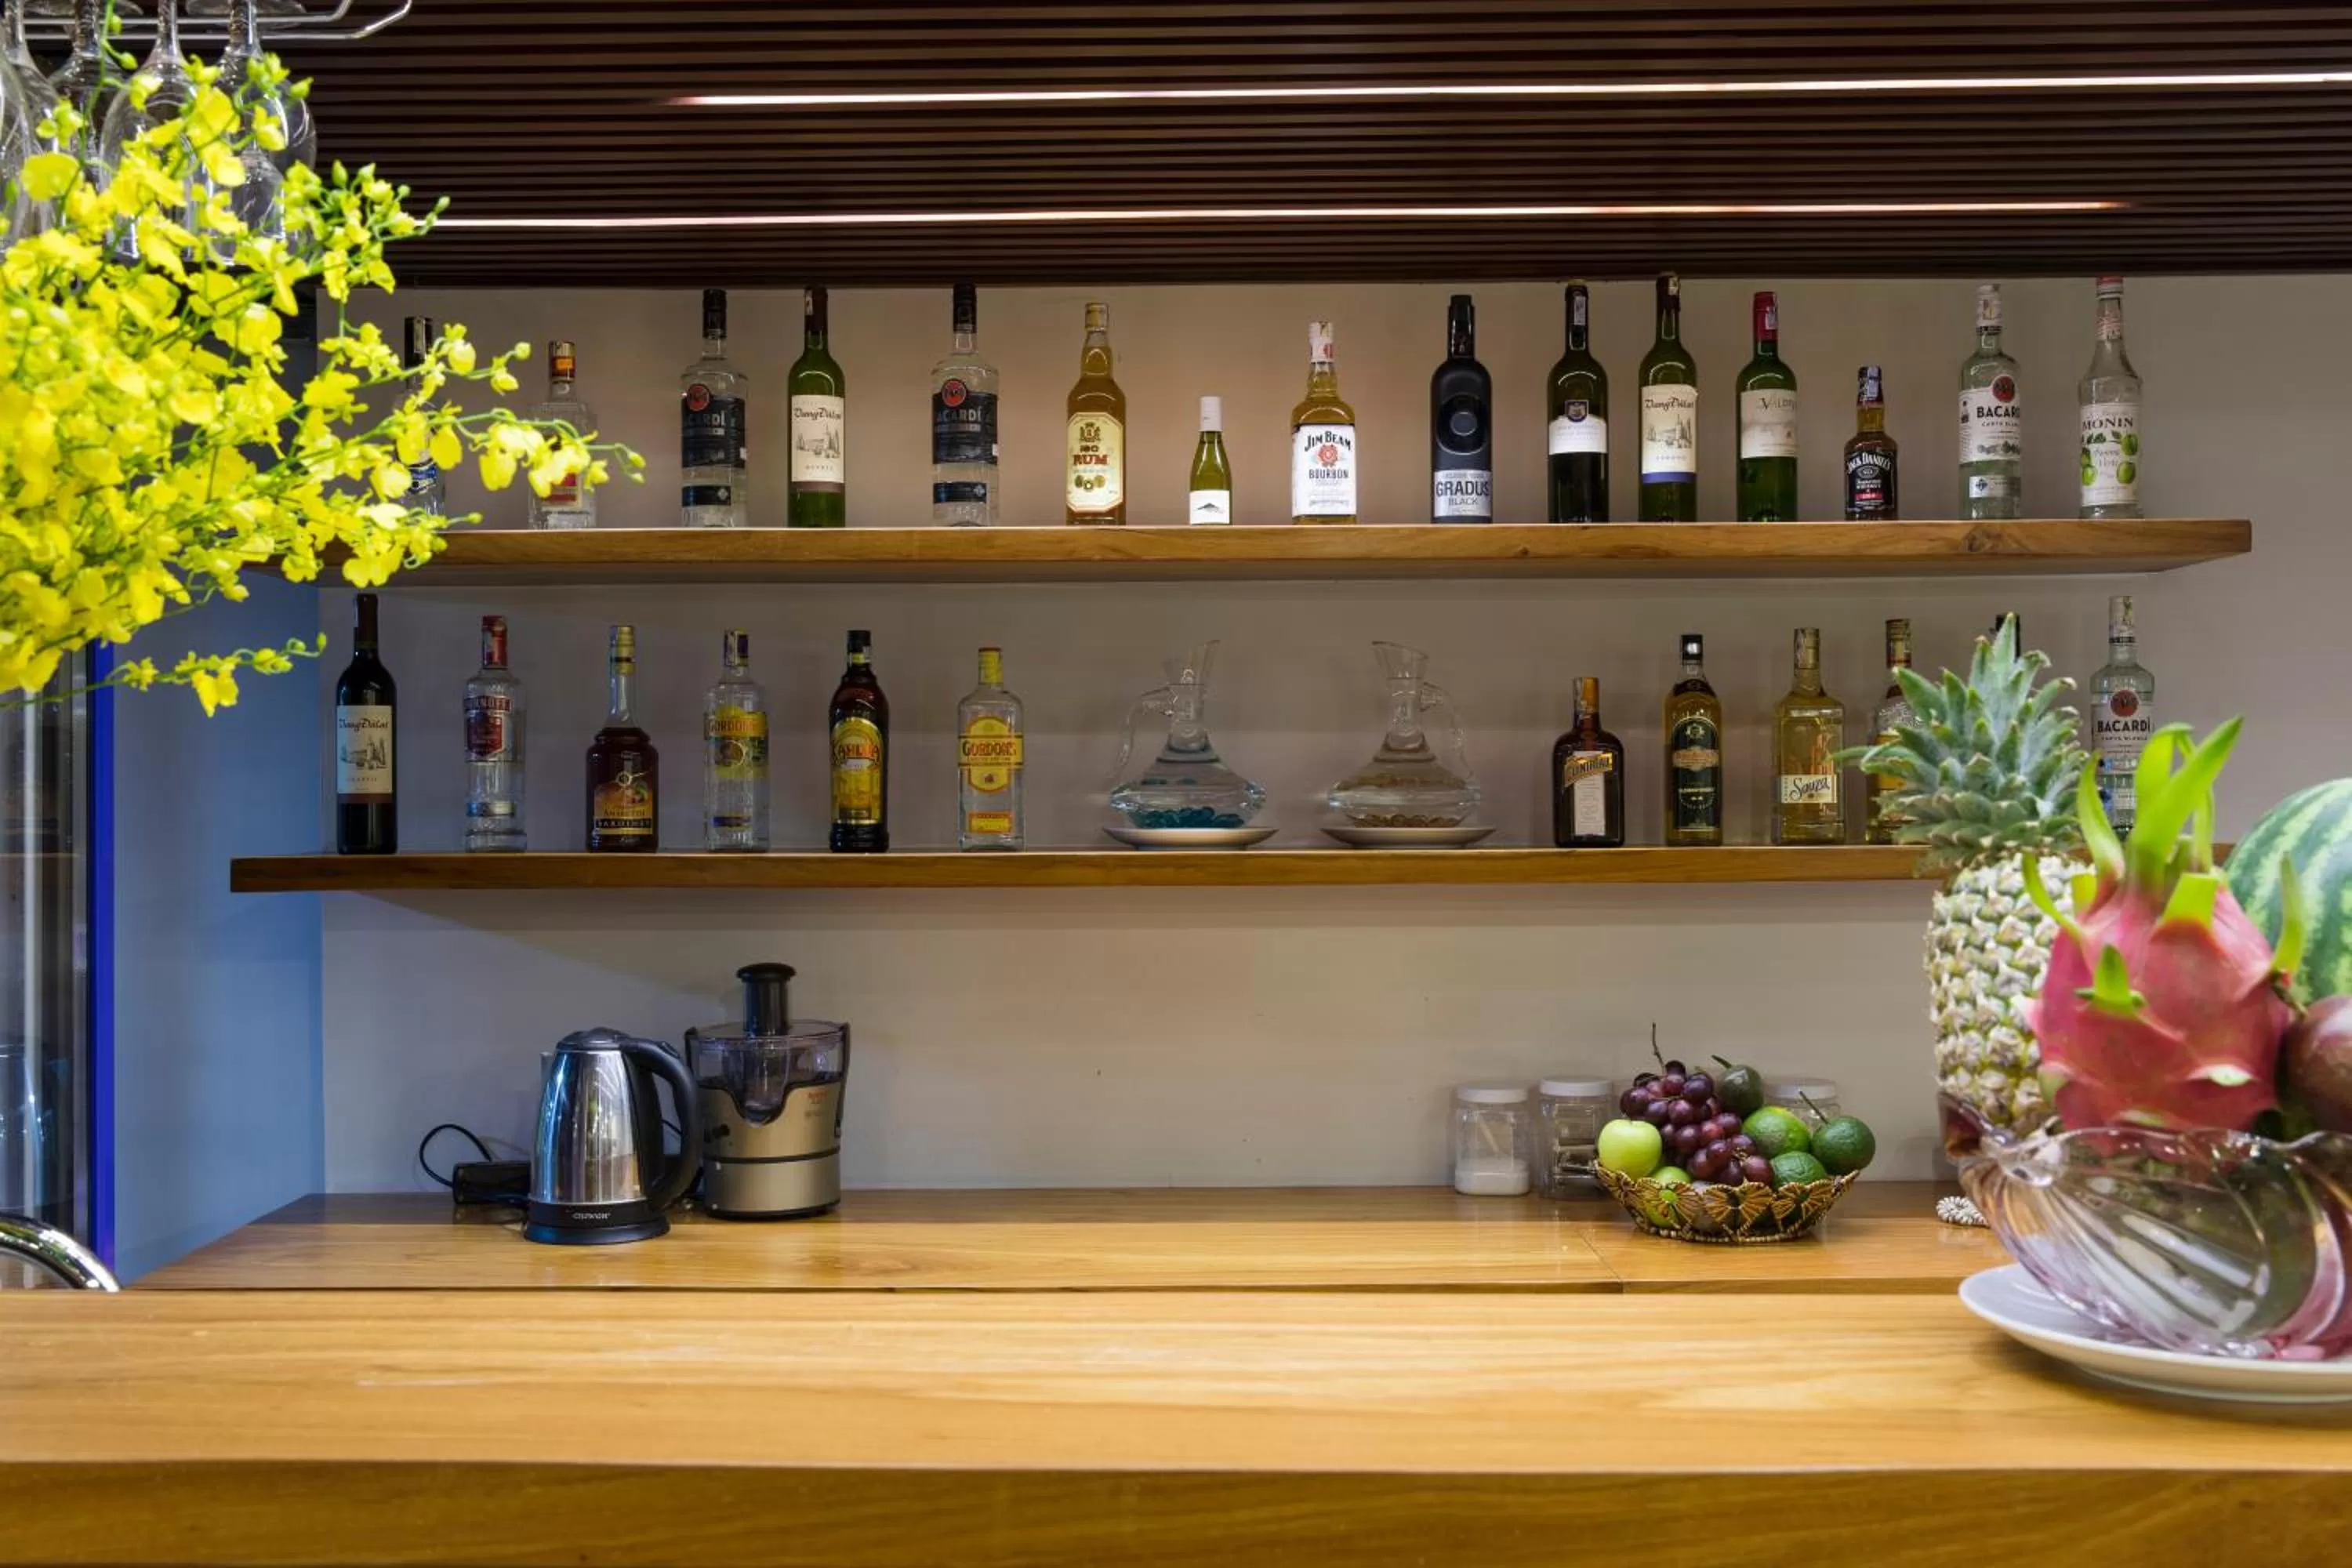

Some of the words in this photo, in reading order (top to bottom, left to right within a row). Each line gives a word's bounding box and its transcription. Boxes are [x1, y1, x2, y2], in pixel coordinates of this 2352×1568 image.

[1976, 405, 2020, 418] BACAR
[2082, 417, 2133, 430] MONIN
[1304, 434, 1323, 452] JIM
[1325, 430, 1352, 451] BEAM
[1073, 454, 1108, 465] RUM
[1308, 469, 1349, 479] BOURBON
[1436, 481, 1490, 497] GRADUS
[962, 740, 1017, 757] GORDON'S
